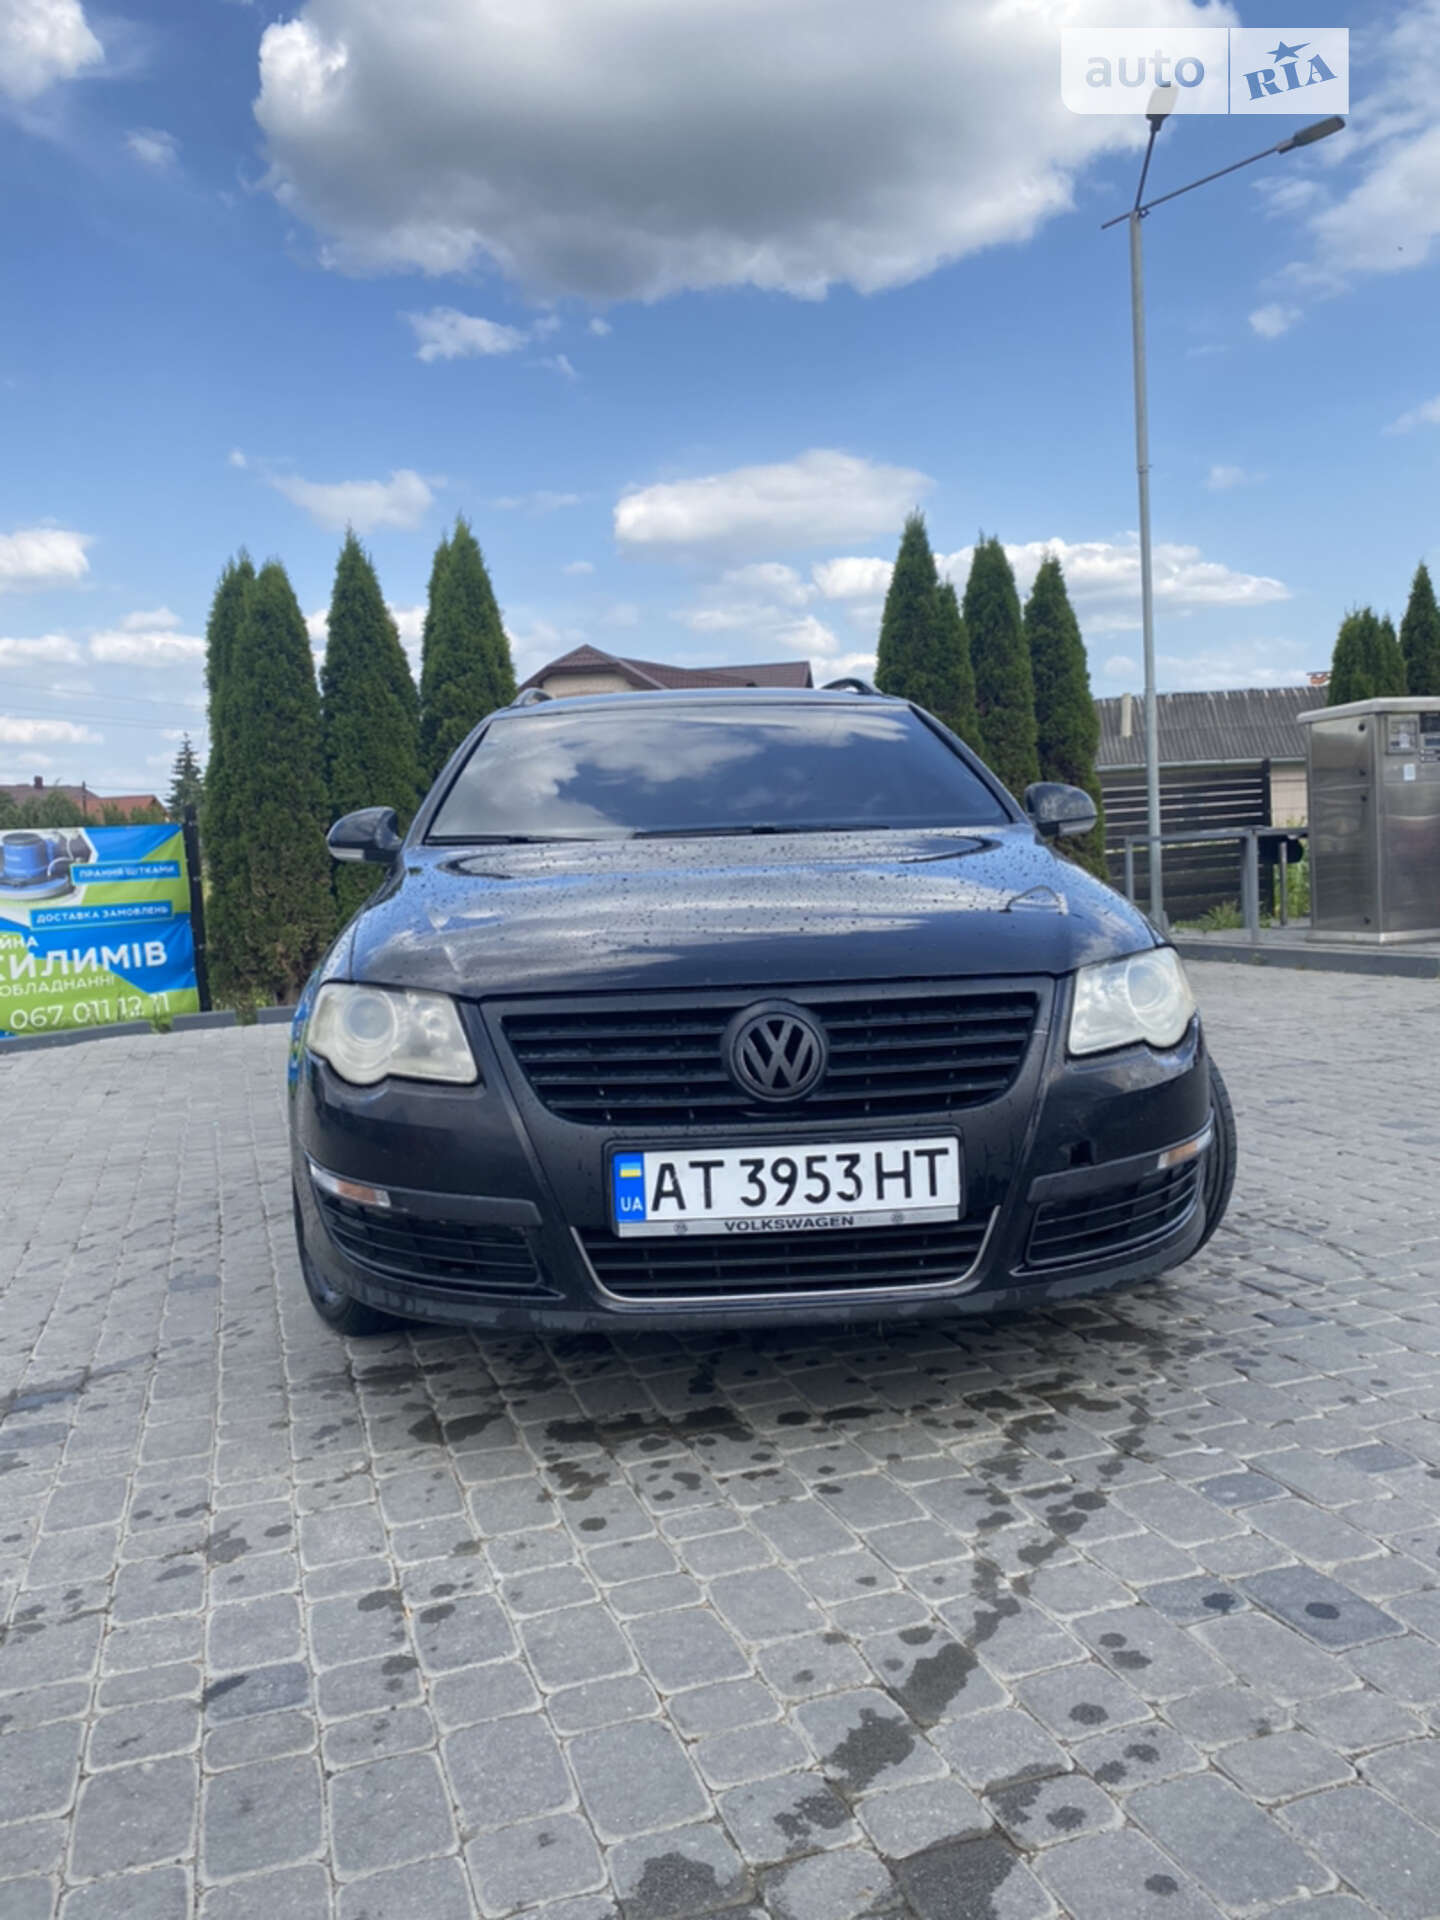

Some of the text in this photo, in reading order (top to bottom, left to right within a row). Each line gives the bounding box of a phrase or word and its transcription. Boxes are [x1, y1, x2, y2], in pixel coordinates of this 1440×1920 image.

[36, 906, 169, 924] ДОСТАВКА ЗАМОВЛЕНЬ
[10, 1004, 64, 1030] 067
[73, 998, 110, 1024] 011
[651, 1147, 950, 1211] AT 3953 HT
[619, 1197, 643, 1211] UA
[724, 1215, 854, 1232] VOLKSWAGEN
